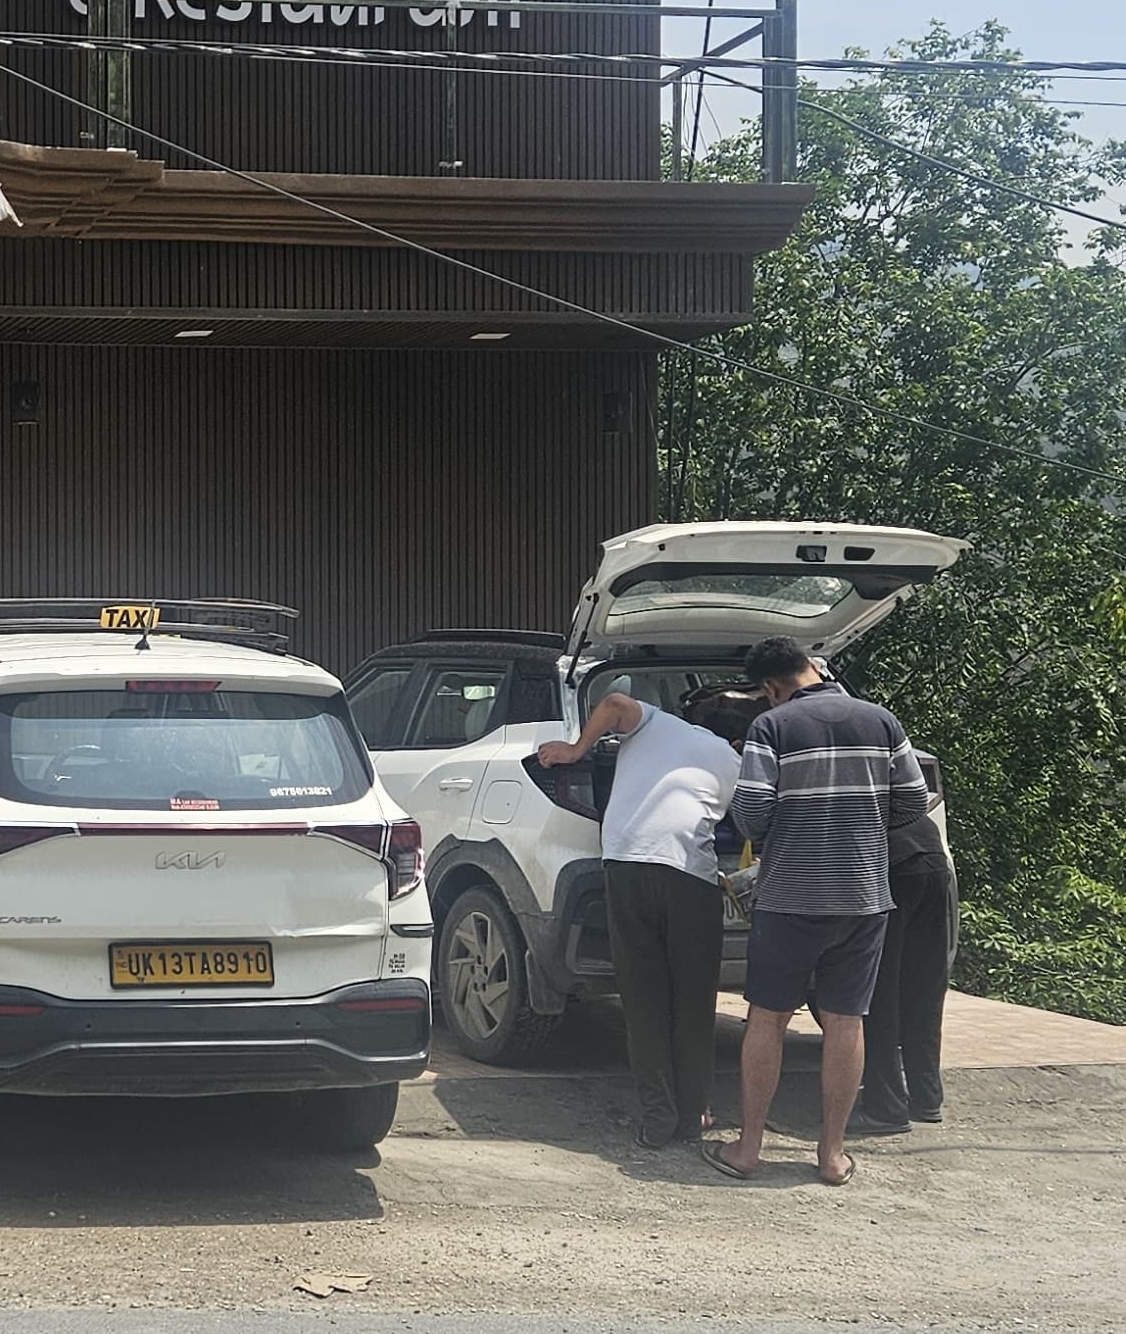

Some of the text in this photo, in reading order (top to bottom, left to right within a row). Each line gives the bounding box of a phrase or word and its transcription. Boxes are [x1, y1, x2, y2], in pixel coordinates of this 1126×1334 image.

[105, 609, 155, 628] TAXI
[155, 851, 226, 869] KIA
[128, 951, 267, 976] UK13TA8910
